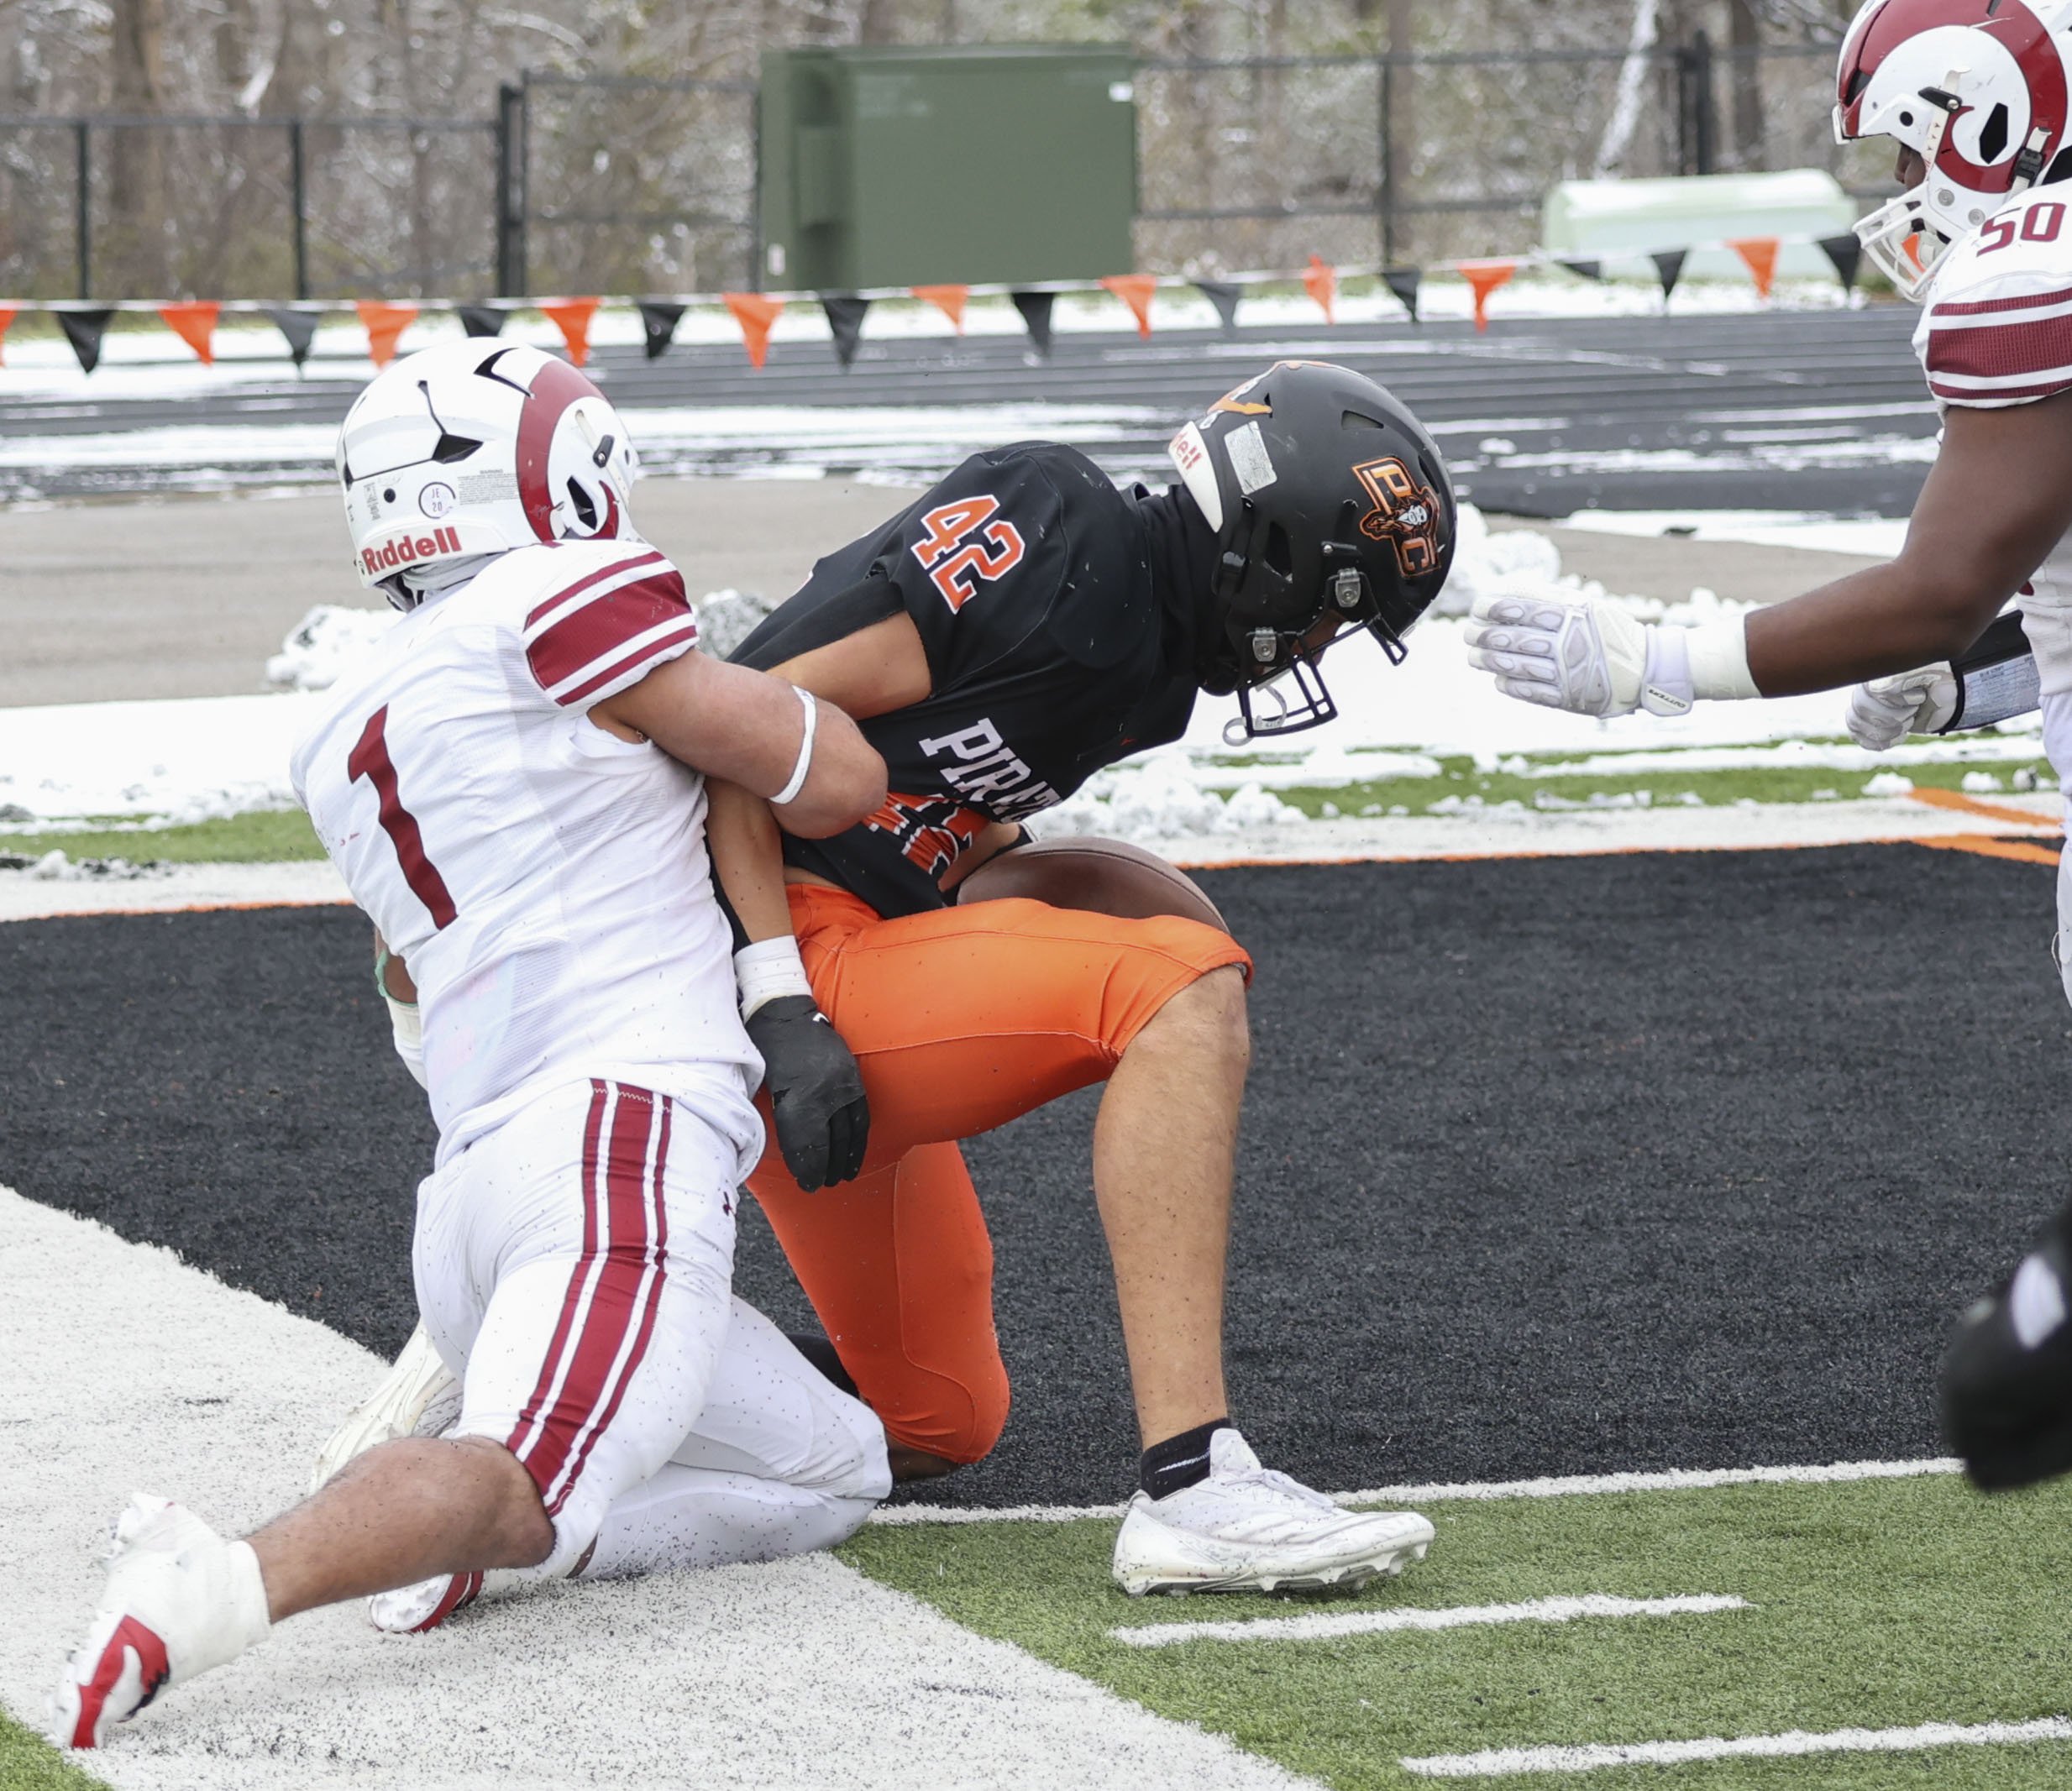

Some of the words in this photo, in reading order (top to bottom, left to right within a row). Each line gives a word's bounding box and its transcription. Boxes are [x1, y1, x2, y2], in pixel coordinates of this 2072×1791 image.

[1976, 202, 2066, 257] 50
[362, 526, 461, 575] Riddell
[911, 495, 1026, 615] 42
[348, 702, 459, 930] 1
